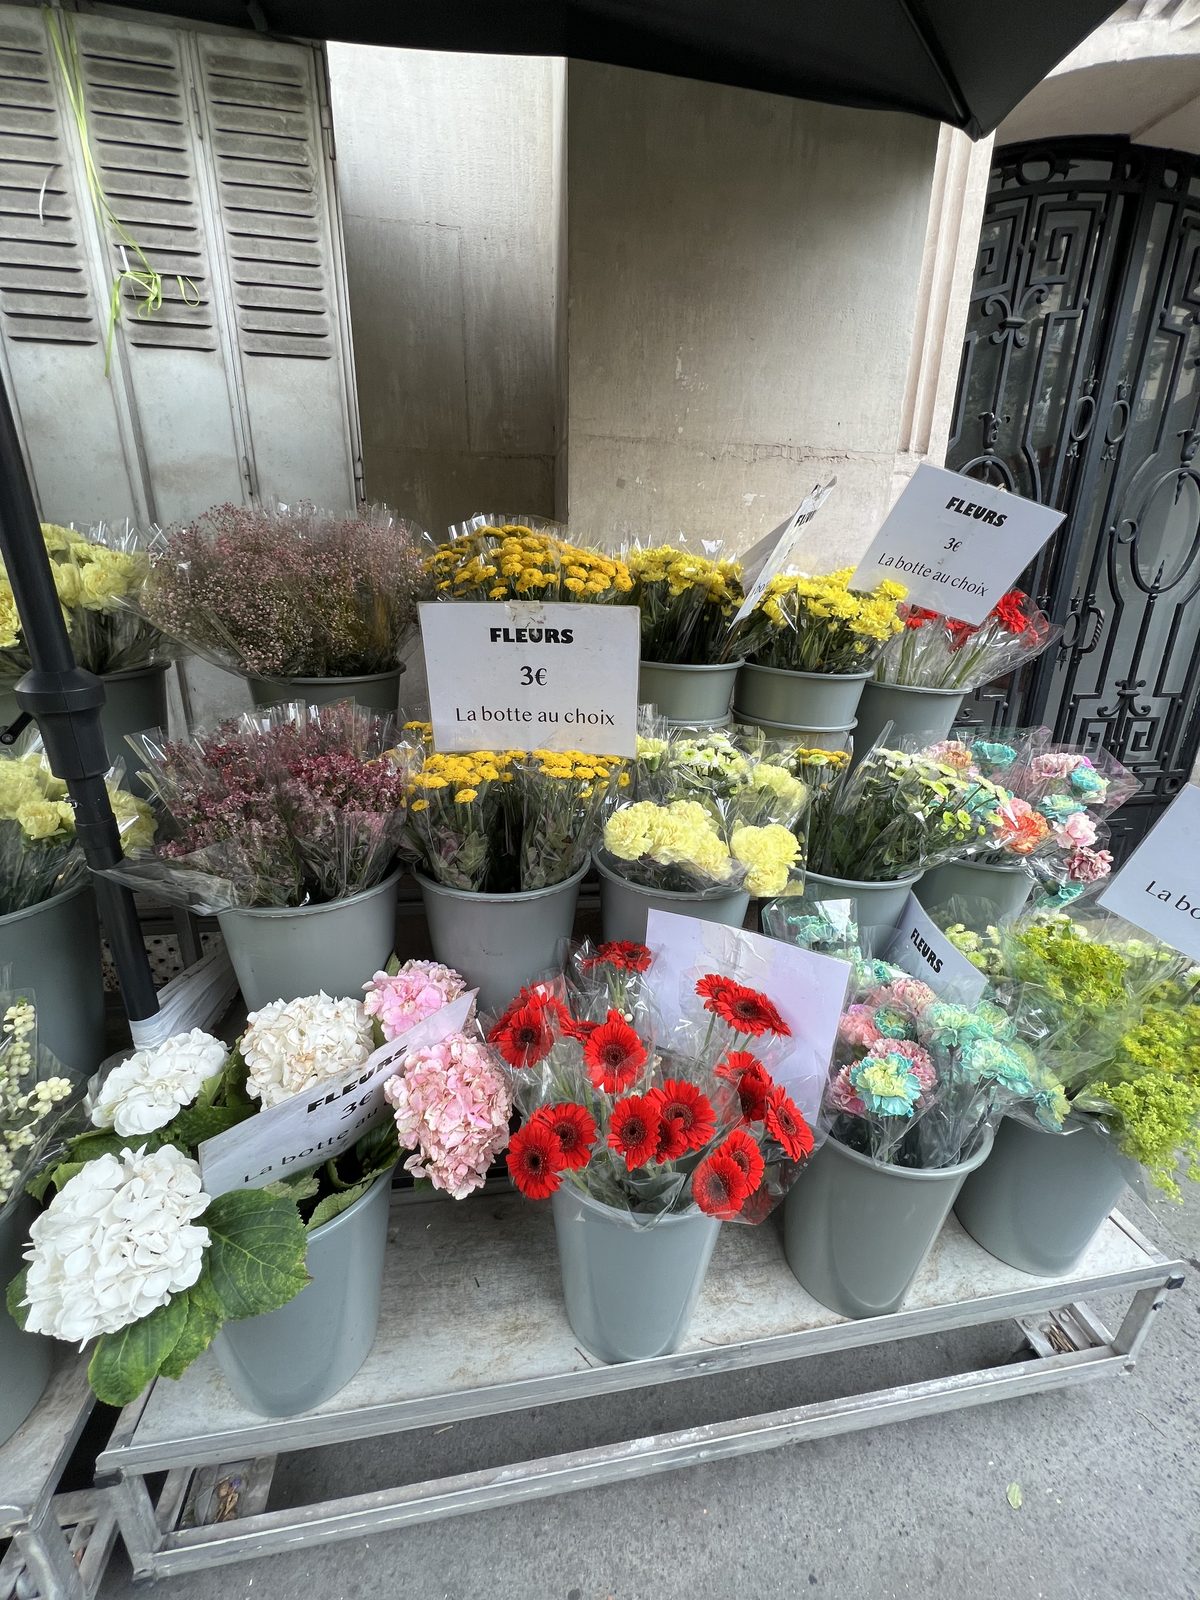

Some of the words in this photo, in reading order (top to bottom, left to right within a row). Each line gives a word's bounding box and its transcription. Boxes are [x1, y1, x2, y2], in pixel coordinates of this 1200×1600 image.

[945, 497, 1007, 527] FLEURS
[944, 537, 963, 552] 3€
[878, 552, 894, 566] La
[895, 553, 932, 578] botte
[932, 570, 950, 583] au
[951, 575, 989, 597] choix
[490, 627, 574, 644] FLEURS
[520, 665, 548, 686] 3€
[456, 707, 477, 722] La
[481, 706, 533, 722] botte
[538, 711, 559, 723] au
[564, 708, 615, 726] choix
[1145, 880, 1171, 902] La
[911, 928, 944, 973] FLEURS
[307, 1045, 408, 1114] FLEURS
[340, 1090, 374, 1120] 3€
[244, 1165, 273, 1183] La
[281, 1130, 349, 1165] botte
[355, 1107, 378, 1129] au
